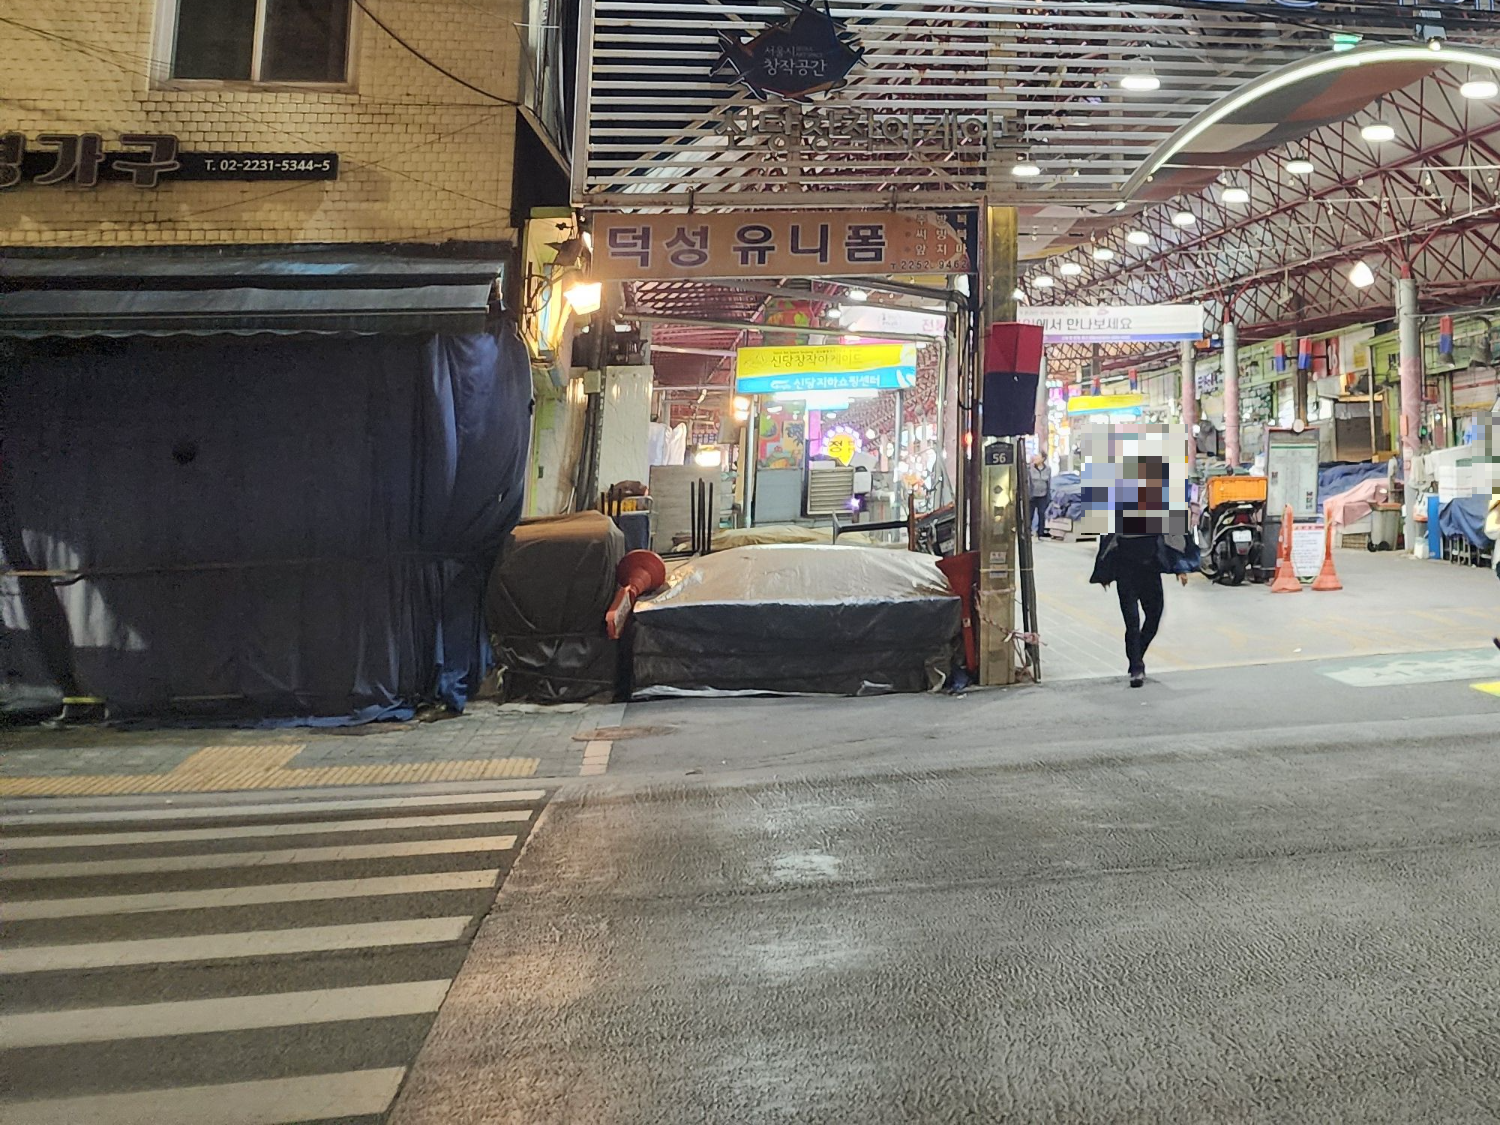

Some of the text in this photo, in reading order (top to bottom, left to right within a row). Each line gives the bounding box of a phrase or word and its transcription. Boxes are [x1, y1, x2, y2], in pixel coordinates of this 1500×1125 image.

[763, 58, 828, 77] 창작공간
[715, 105, 1031, 154] 신당창작아케이드
[220, 159, 330, 173] 02-2231-5344~5
[607, 223, 887, 267] 덕성 유니폼
[992, 452, 1007, 464] 56
